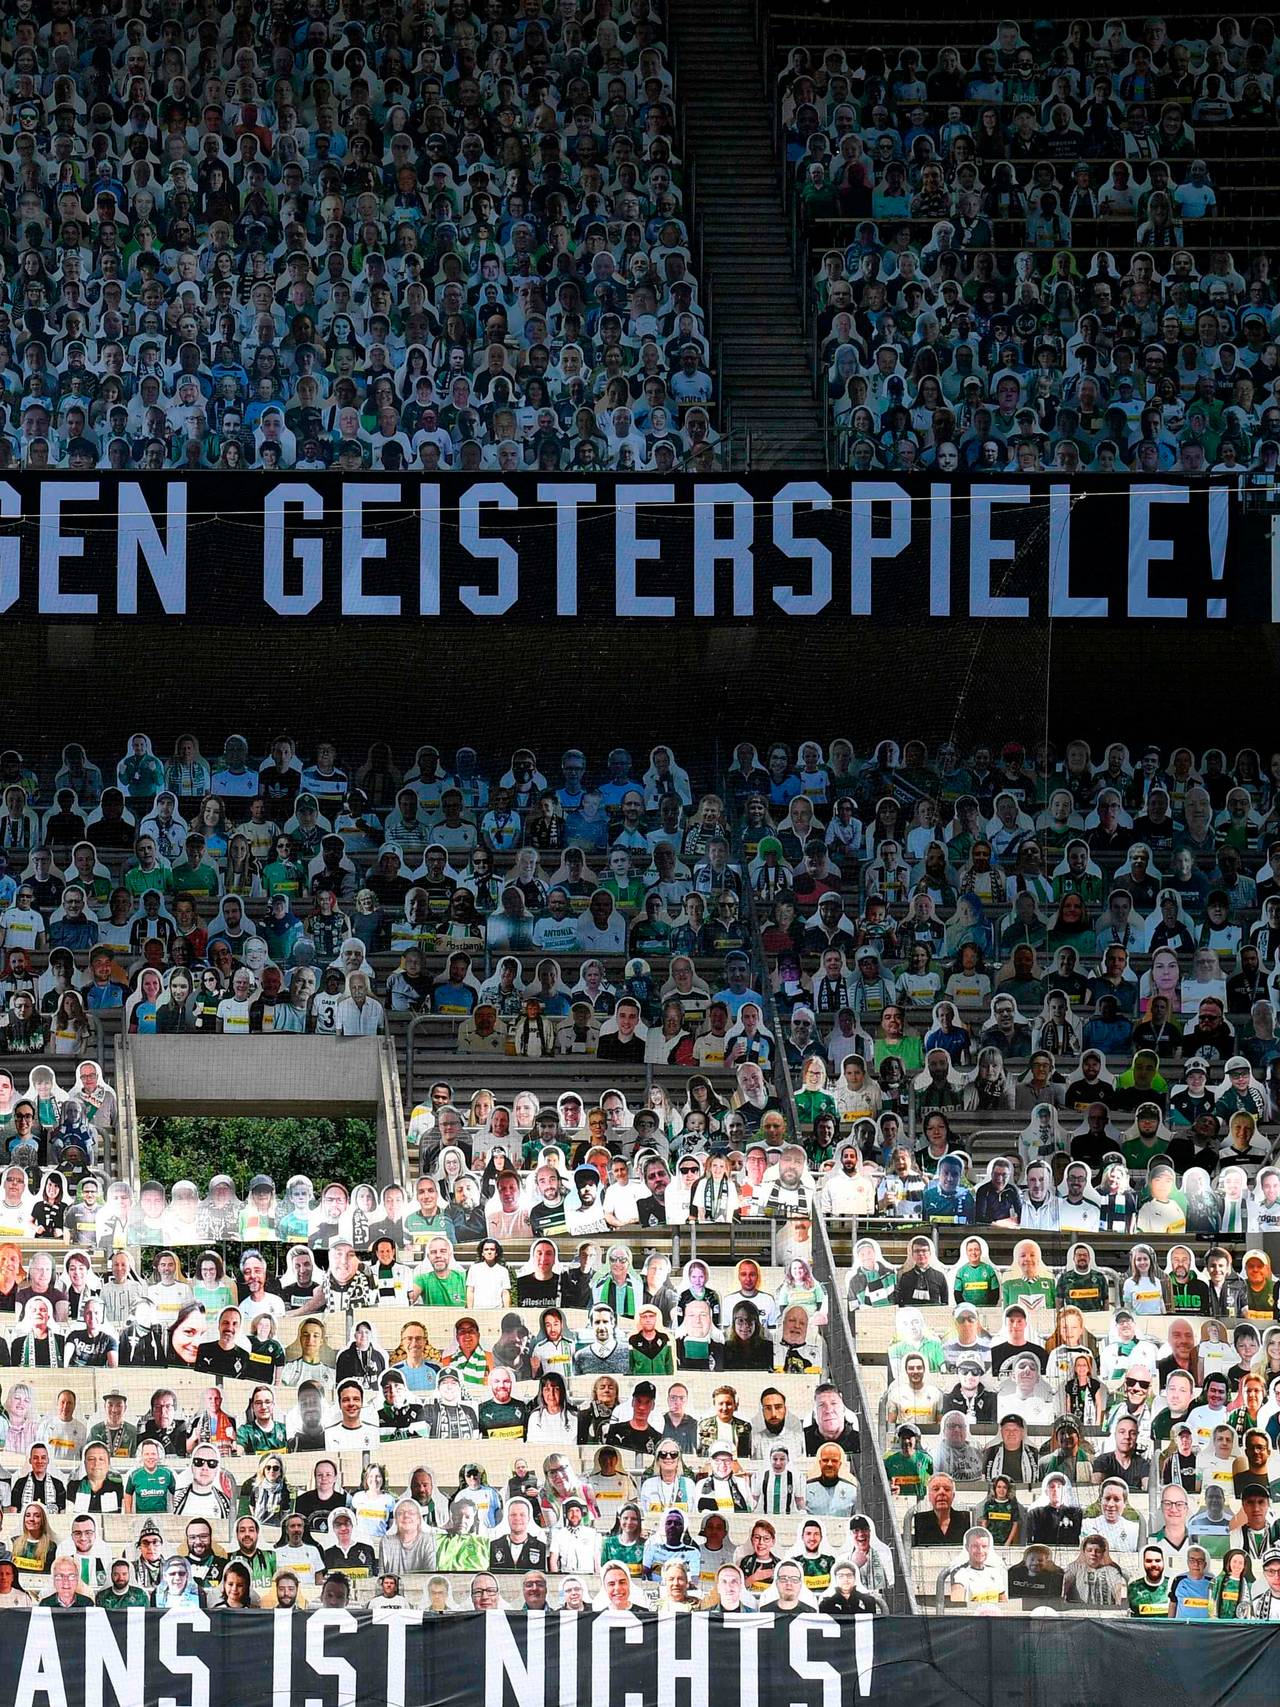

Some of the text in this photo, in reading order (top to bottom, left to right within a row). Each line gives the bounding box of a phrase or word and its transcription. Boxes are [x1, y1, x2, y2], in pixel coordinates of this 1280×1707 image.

[263, 480, 1230, 619] GEISTERSPIELE!
[446, 938, 484, 952] Postbank
[544, 930, 574, 938] ANTONIA
[323, 1007, 334, 1029] 3
[272, 1608, 424, 1707] IST
